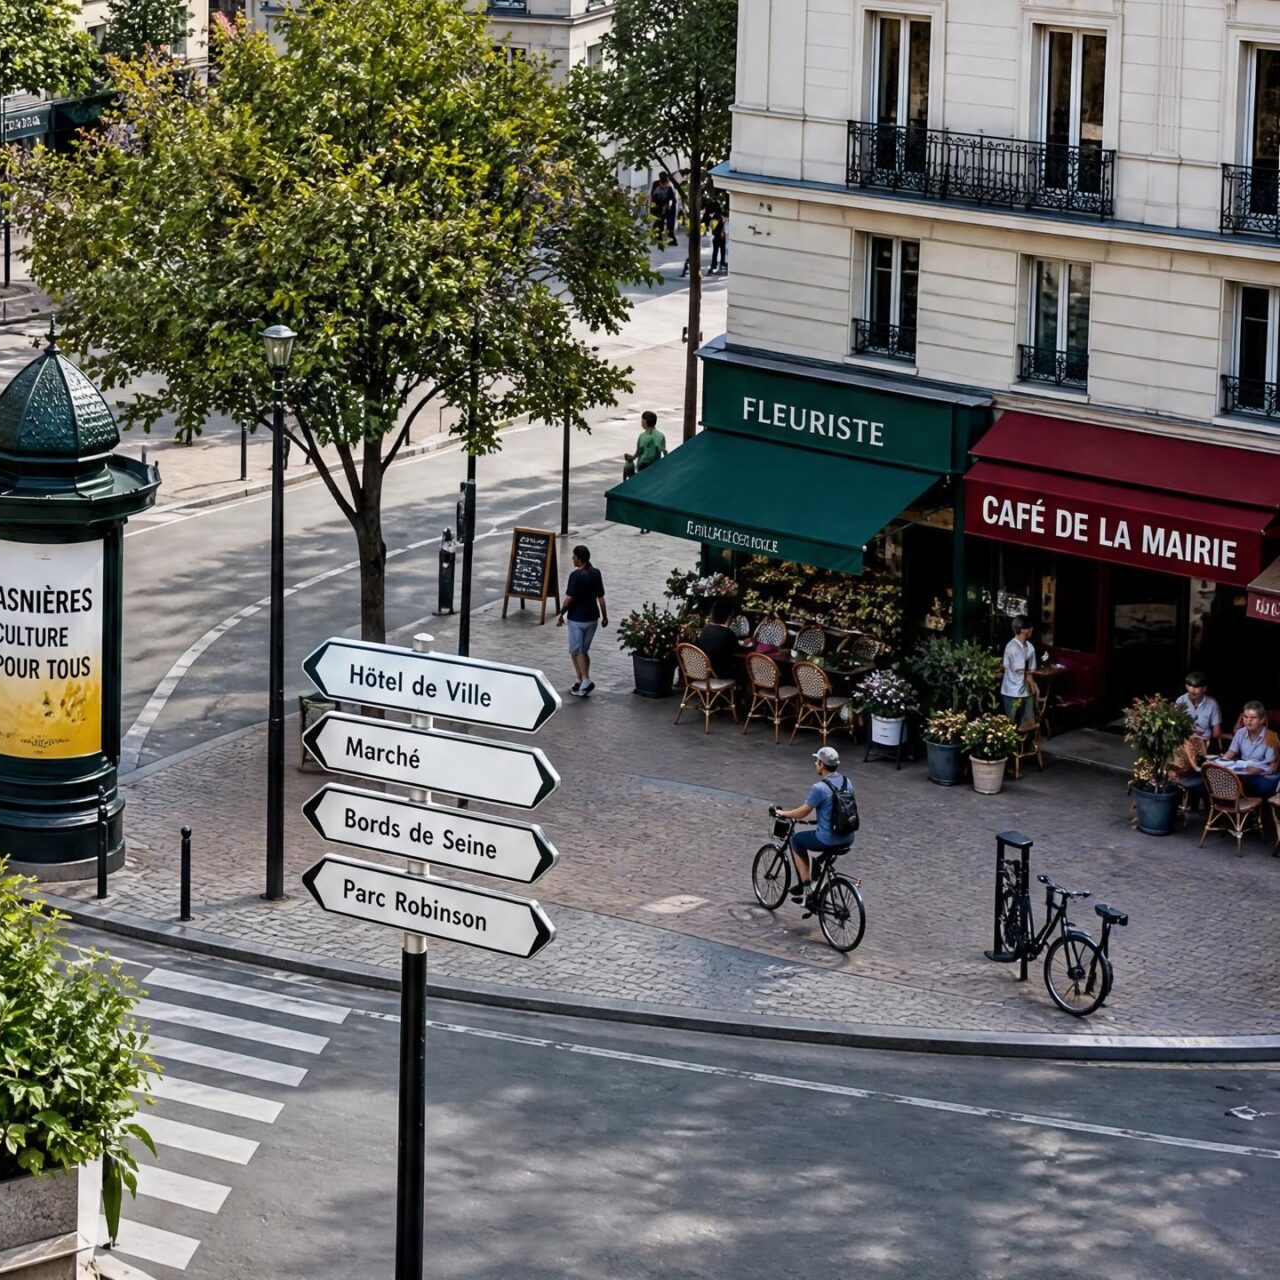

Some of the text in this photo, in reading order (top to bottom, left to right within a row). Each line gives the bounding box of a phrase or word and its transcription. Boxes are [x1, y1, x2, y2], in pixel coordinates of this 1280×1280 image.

[742, 395, 885, 448] FLEURISTE
[982, 495, 1238, 571] CAFÉ DE LA MAIRIE
[46, 655, 91, 680] TOUS
[411, 674, 438, 698] de
[445, 679, 492, 708] Ville
[345, 736, 420, 769] Marché
[344, 807, 497, 860] Bords de Seine
[343, 878, 487, 932] Parc Robinson
